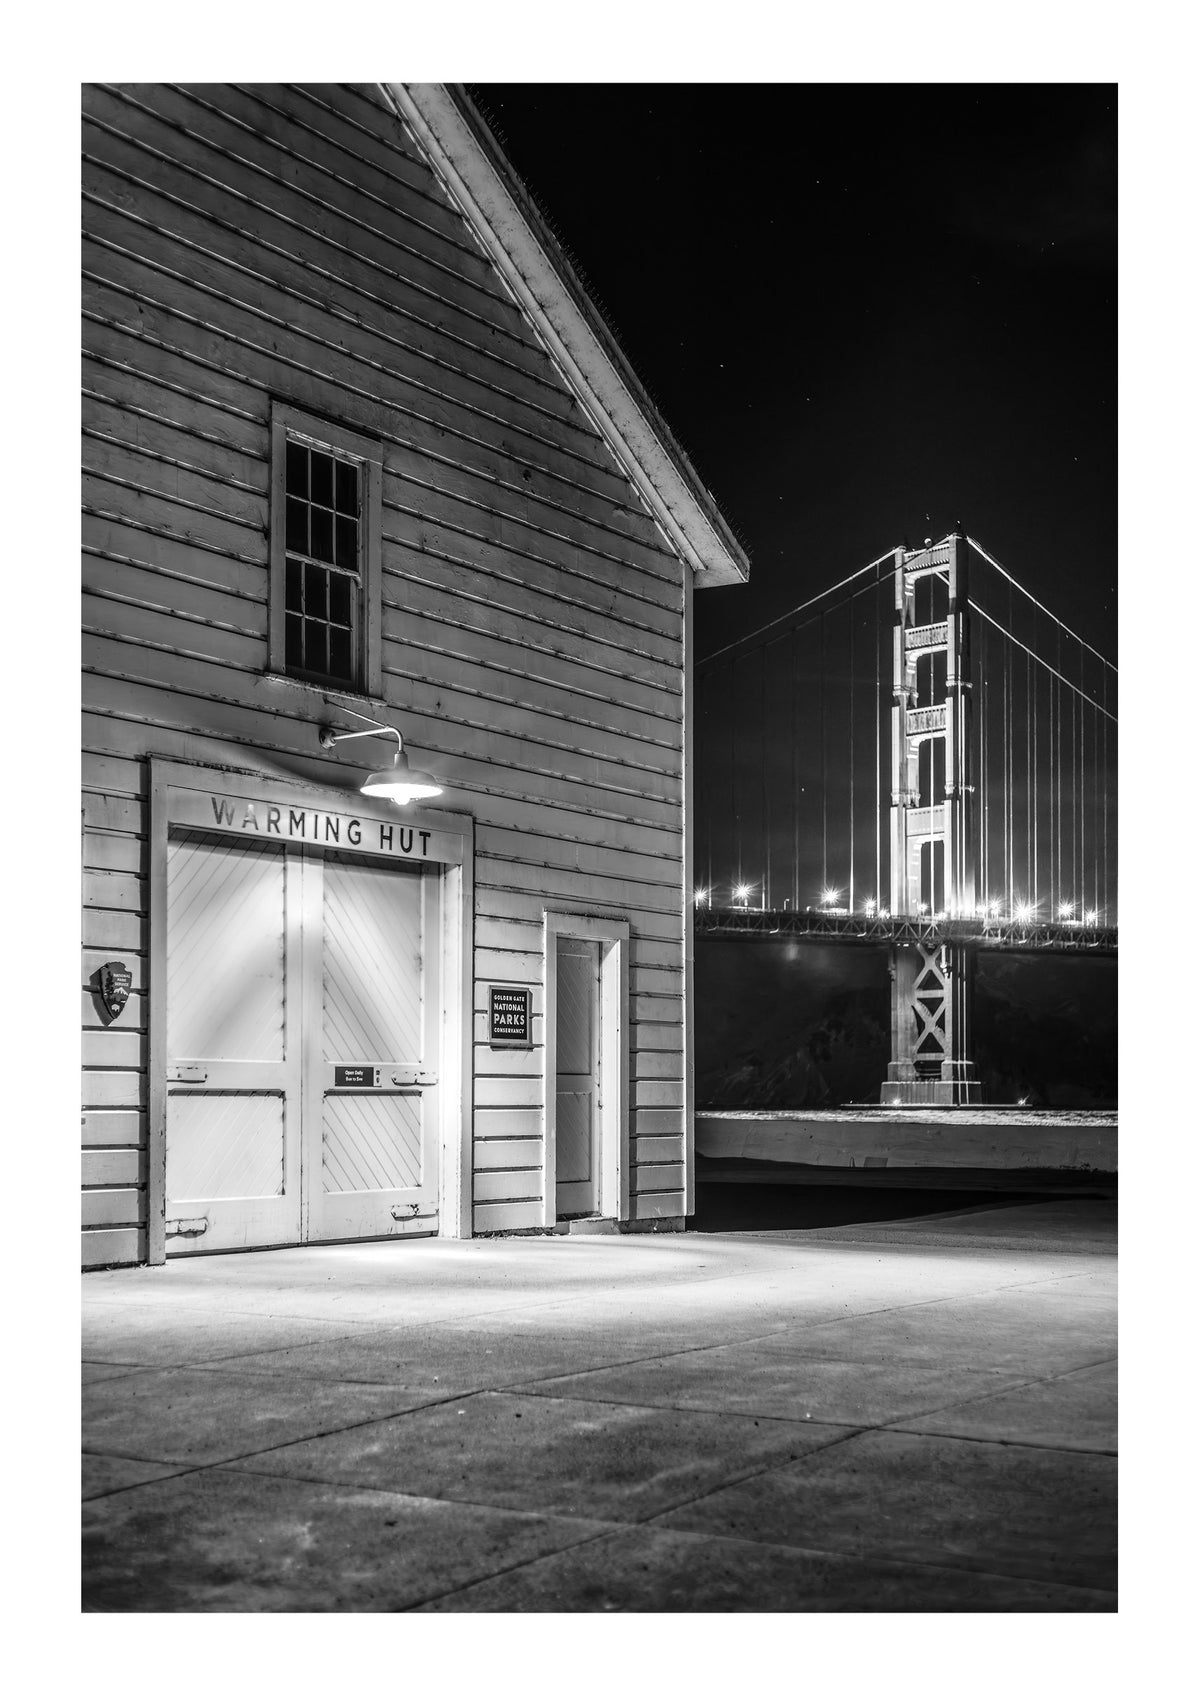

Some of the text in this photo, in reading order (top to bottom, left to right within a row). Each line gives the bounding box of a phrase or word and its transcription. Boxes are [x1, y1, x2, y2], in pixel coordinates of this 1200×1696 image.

[211, 797, 431, 856] WARMING HUT
[494, 1003, 525, 1011] NATIONAL
[494, 1013, 525, 1025] PARKS
